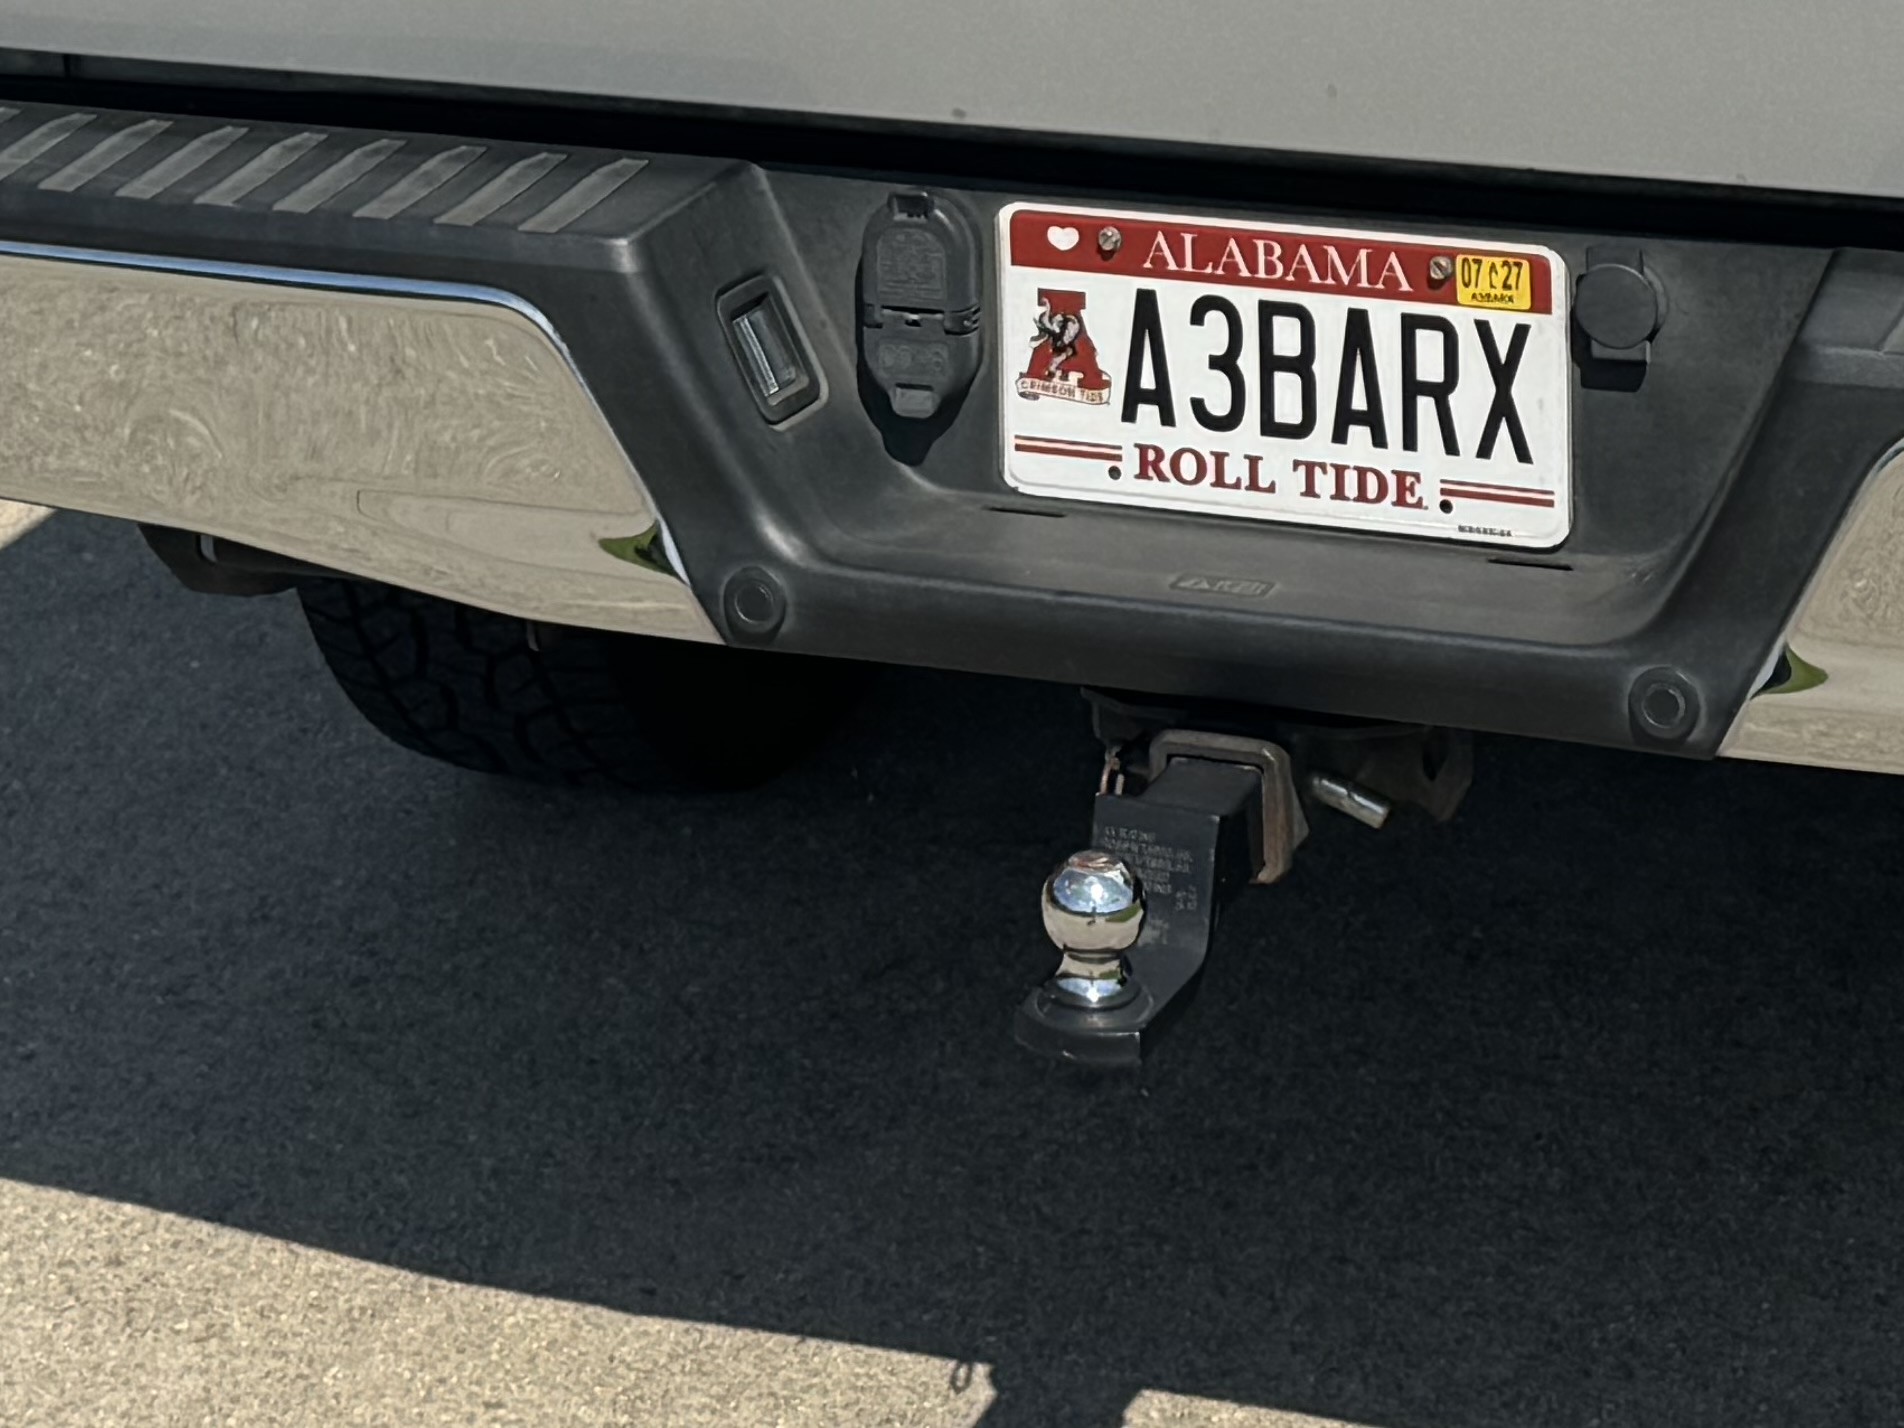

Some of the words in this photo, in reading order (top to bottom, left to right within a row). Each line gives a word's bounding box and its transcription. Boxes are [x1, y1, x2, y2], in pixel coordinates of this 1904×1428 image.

[1142, 230, 1415, 294] ALABAMA
[1461, 256, 1483, 289] 07
[1501, 259, 1524, 291] 27
[1020, 379, 1076, 398] CRIMSON
[1120, 287, 1534, 465] A3BARX
[1132, 442, 1277, 495] ROLL
[1291, 458, 1427, 511] TIDE
